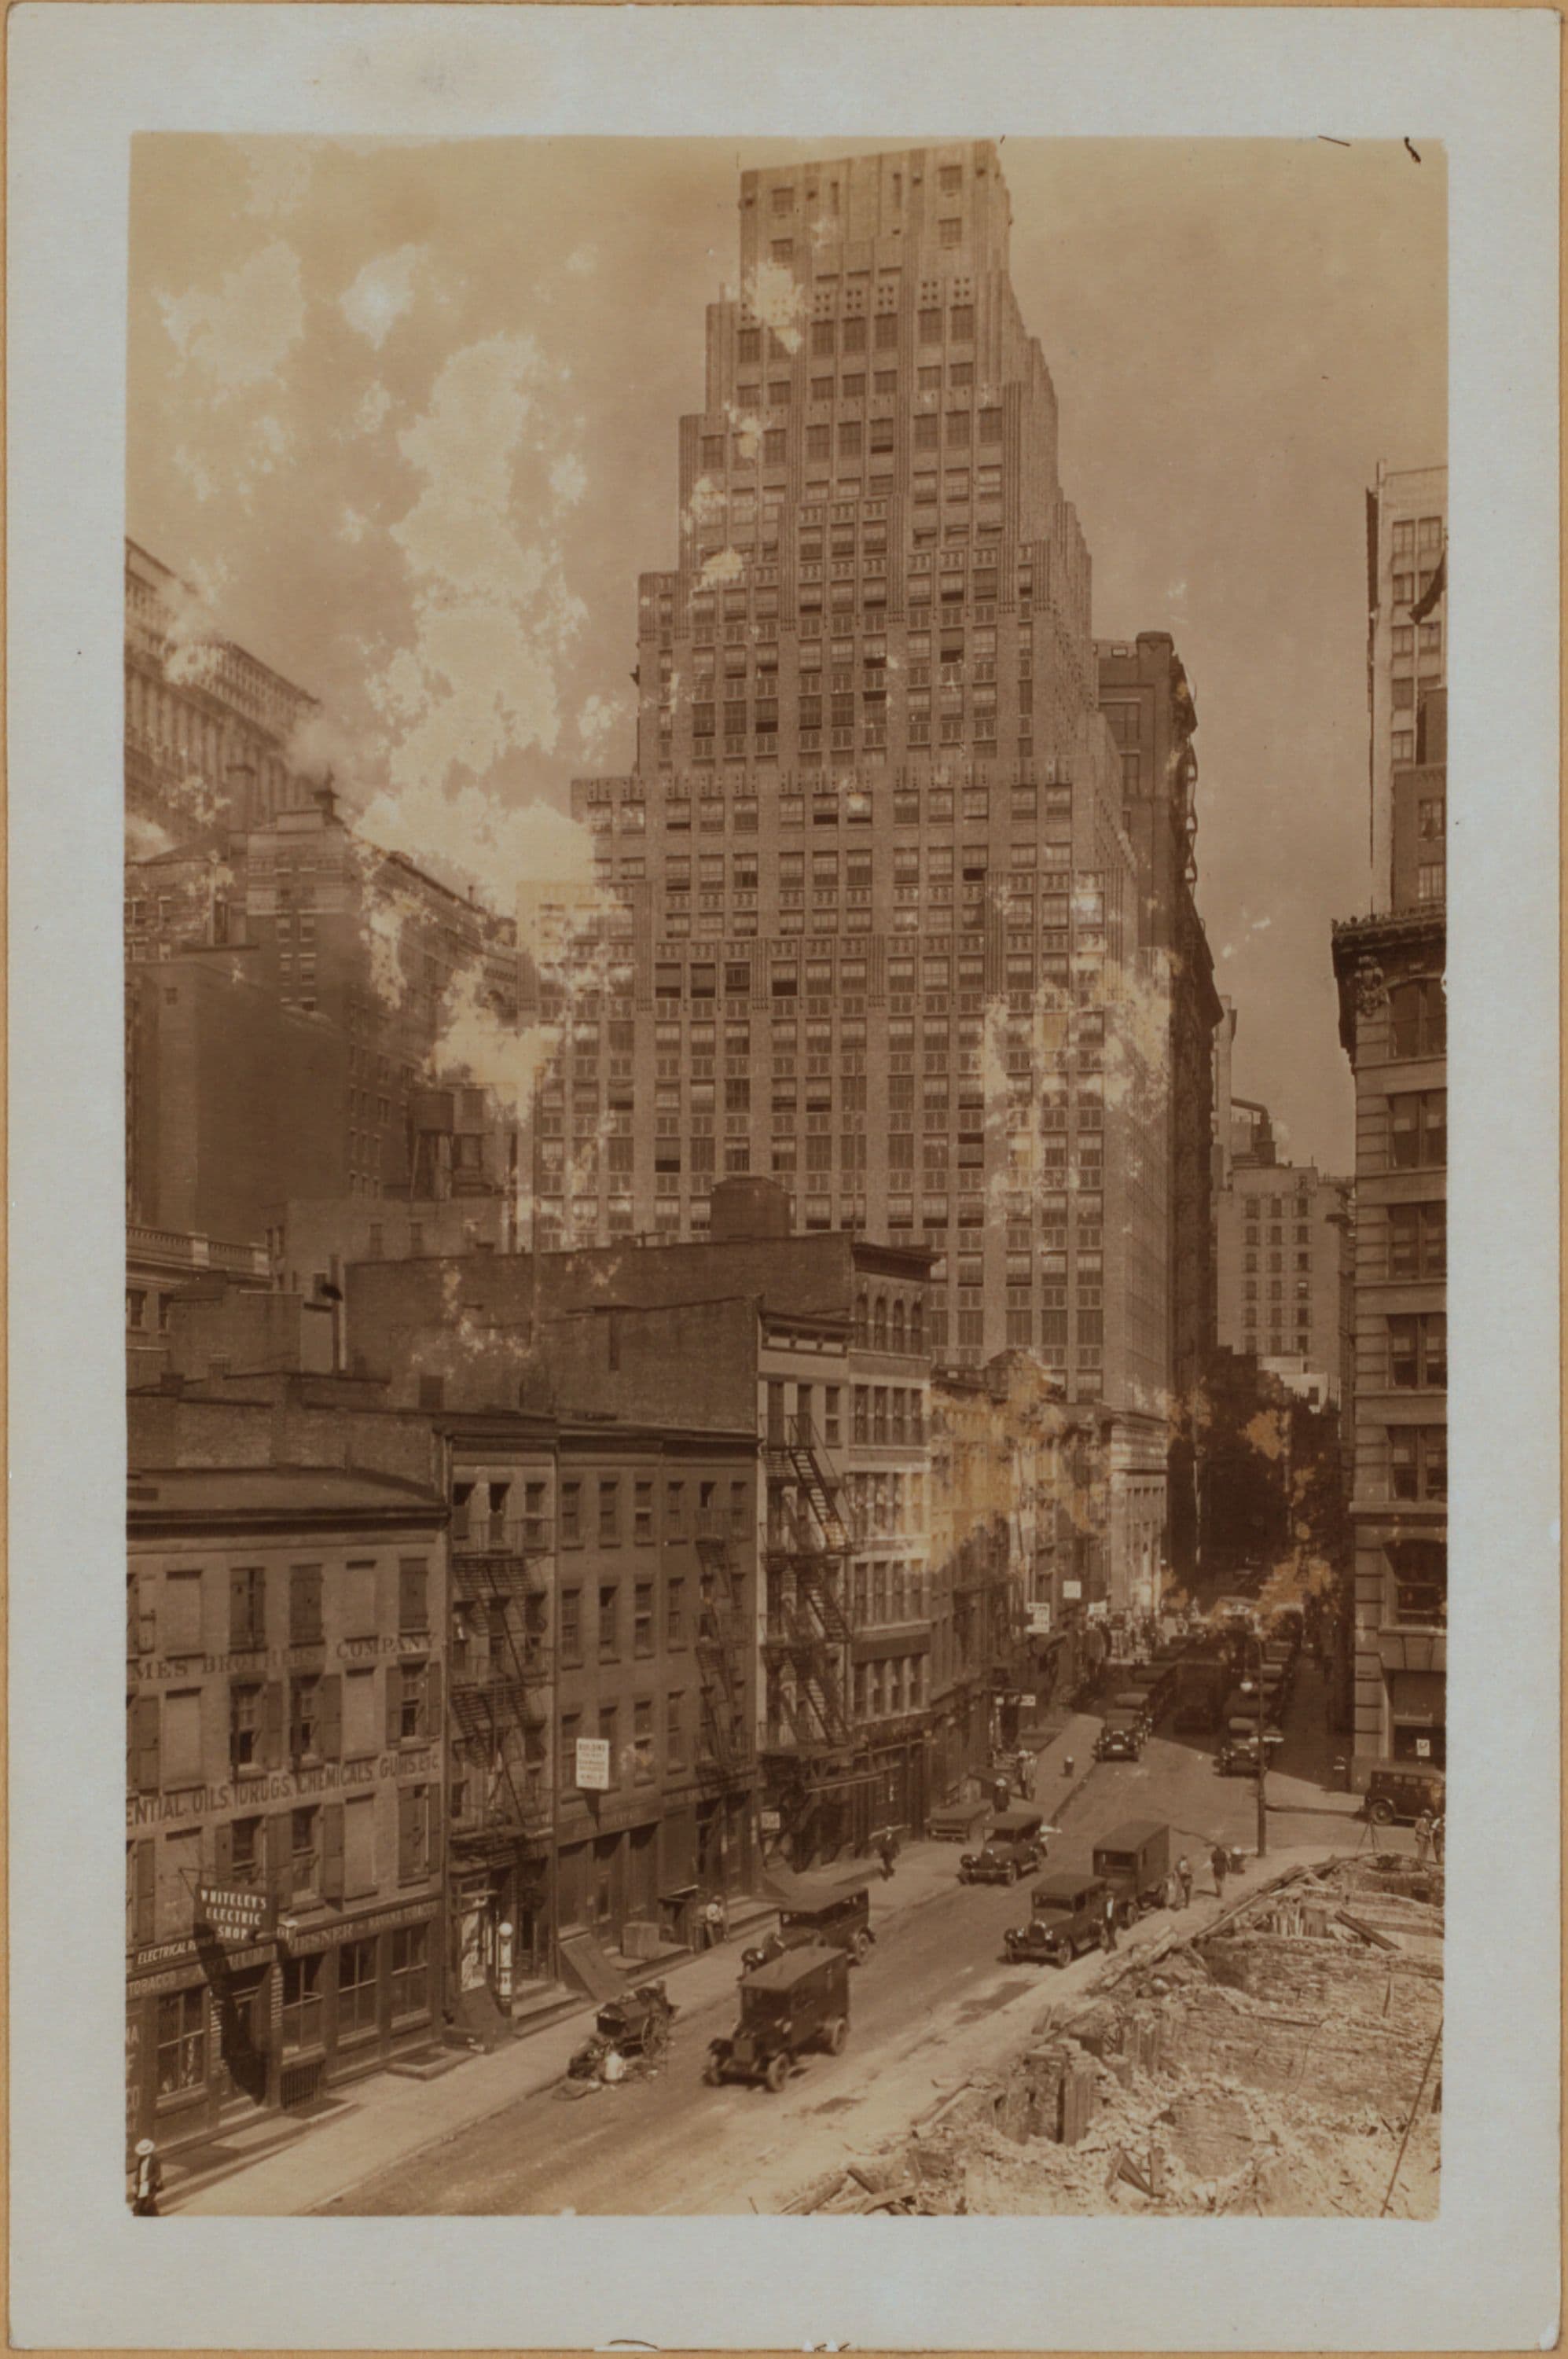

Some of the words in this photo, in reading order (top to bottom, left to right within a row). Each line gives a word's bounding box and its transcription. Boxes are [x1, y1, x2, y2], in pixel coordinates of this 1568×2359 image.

[206, 1907, 262, 1925] ELECTRIC
[218, 1925, 248, 1940] SHOP
[138, 1941, 186, 1964] ELECTRICAL
